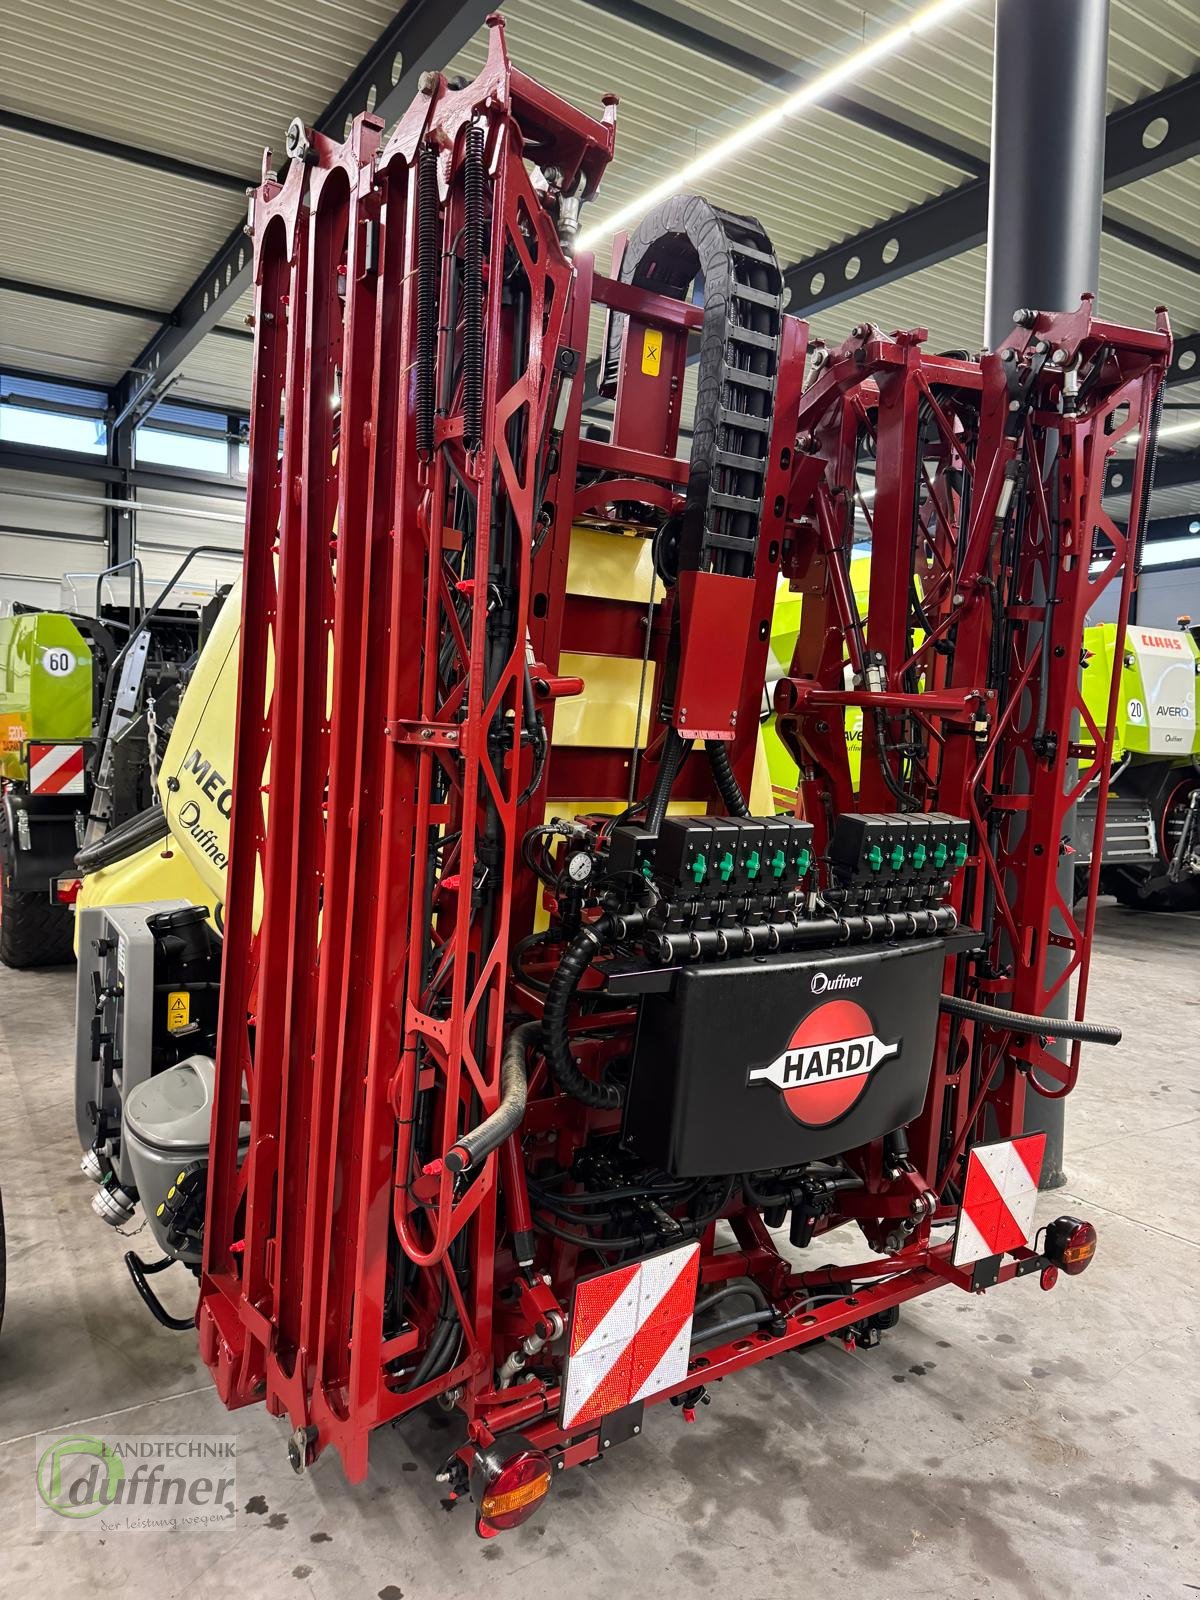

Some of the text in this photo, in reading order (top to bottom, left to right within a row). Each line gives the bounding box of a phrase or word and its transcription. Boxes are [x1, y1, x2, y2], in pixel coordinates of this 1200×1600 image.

[1141, 634, 1182, 650] CLAAS
[50, 653, 69, 672] 60
[1130, 702, 1142, 718] 20
[1156, 705, 1189, 718] AVERO
[183, 749, 233, 820] MEG
[179, 800, 229, 870] Duffner
[811, 972, 863, 994] Duffner
[783, 1040, 874, 1084] HARDI
